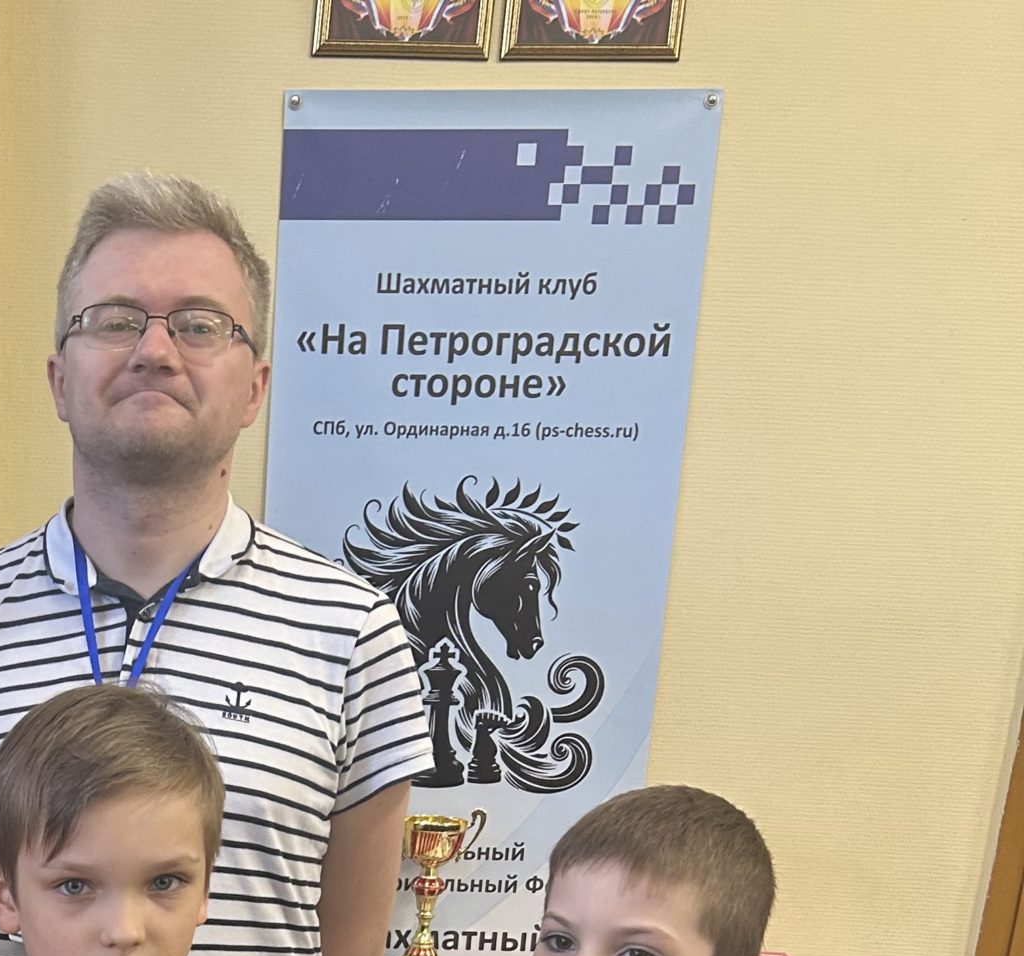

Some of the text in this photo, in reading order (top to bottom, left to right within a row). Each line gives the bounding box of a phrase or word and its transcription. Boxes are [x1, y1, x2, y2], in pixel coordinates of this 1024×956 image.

[376, 272, 598, 300] Шахматный клуб
[296, 322, 672, 364] «На Петроградской
[391, 372, 567, 406] стороне»
[312, 420, 640, 442] СПб, ул. Ординарная д.16 (ps-chess.ru)
[463, 841, 525, 861] ьный
